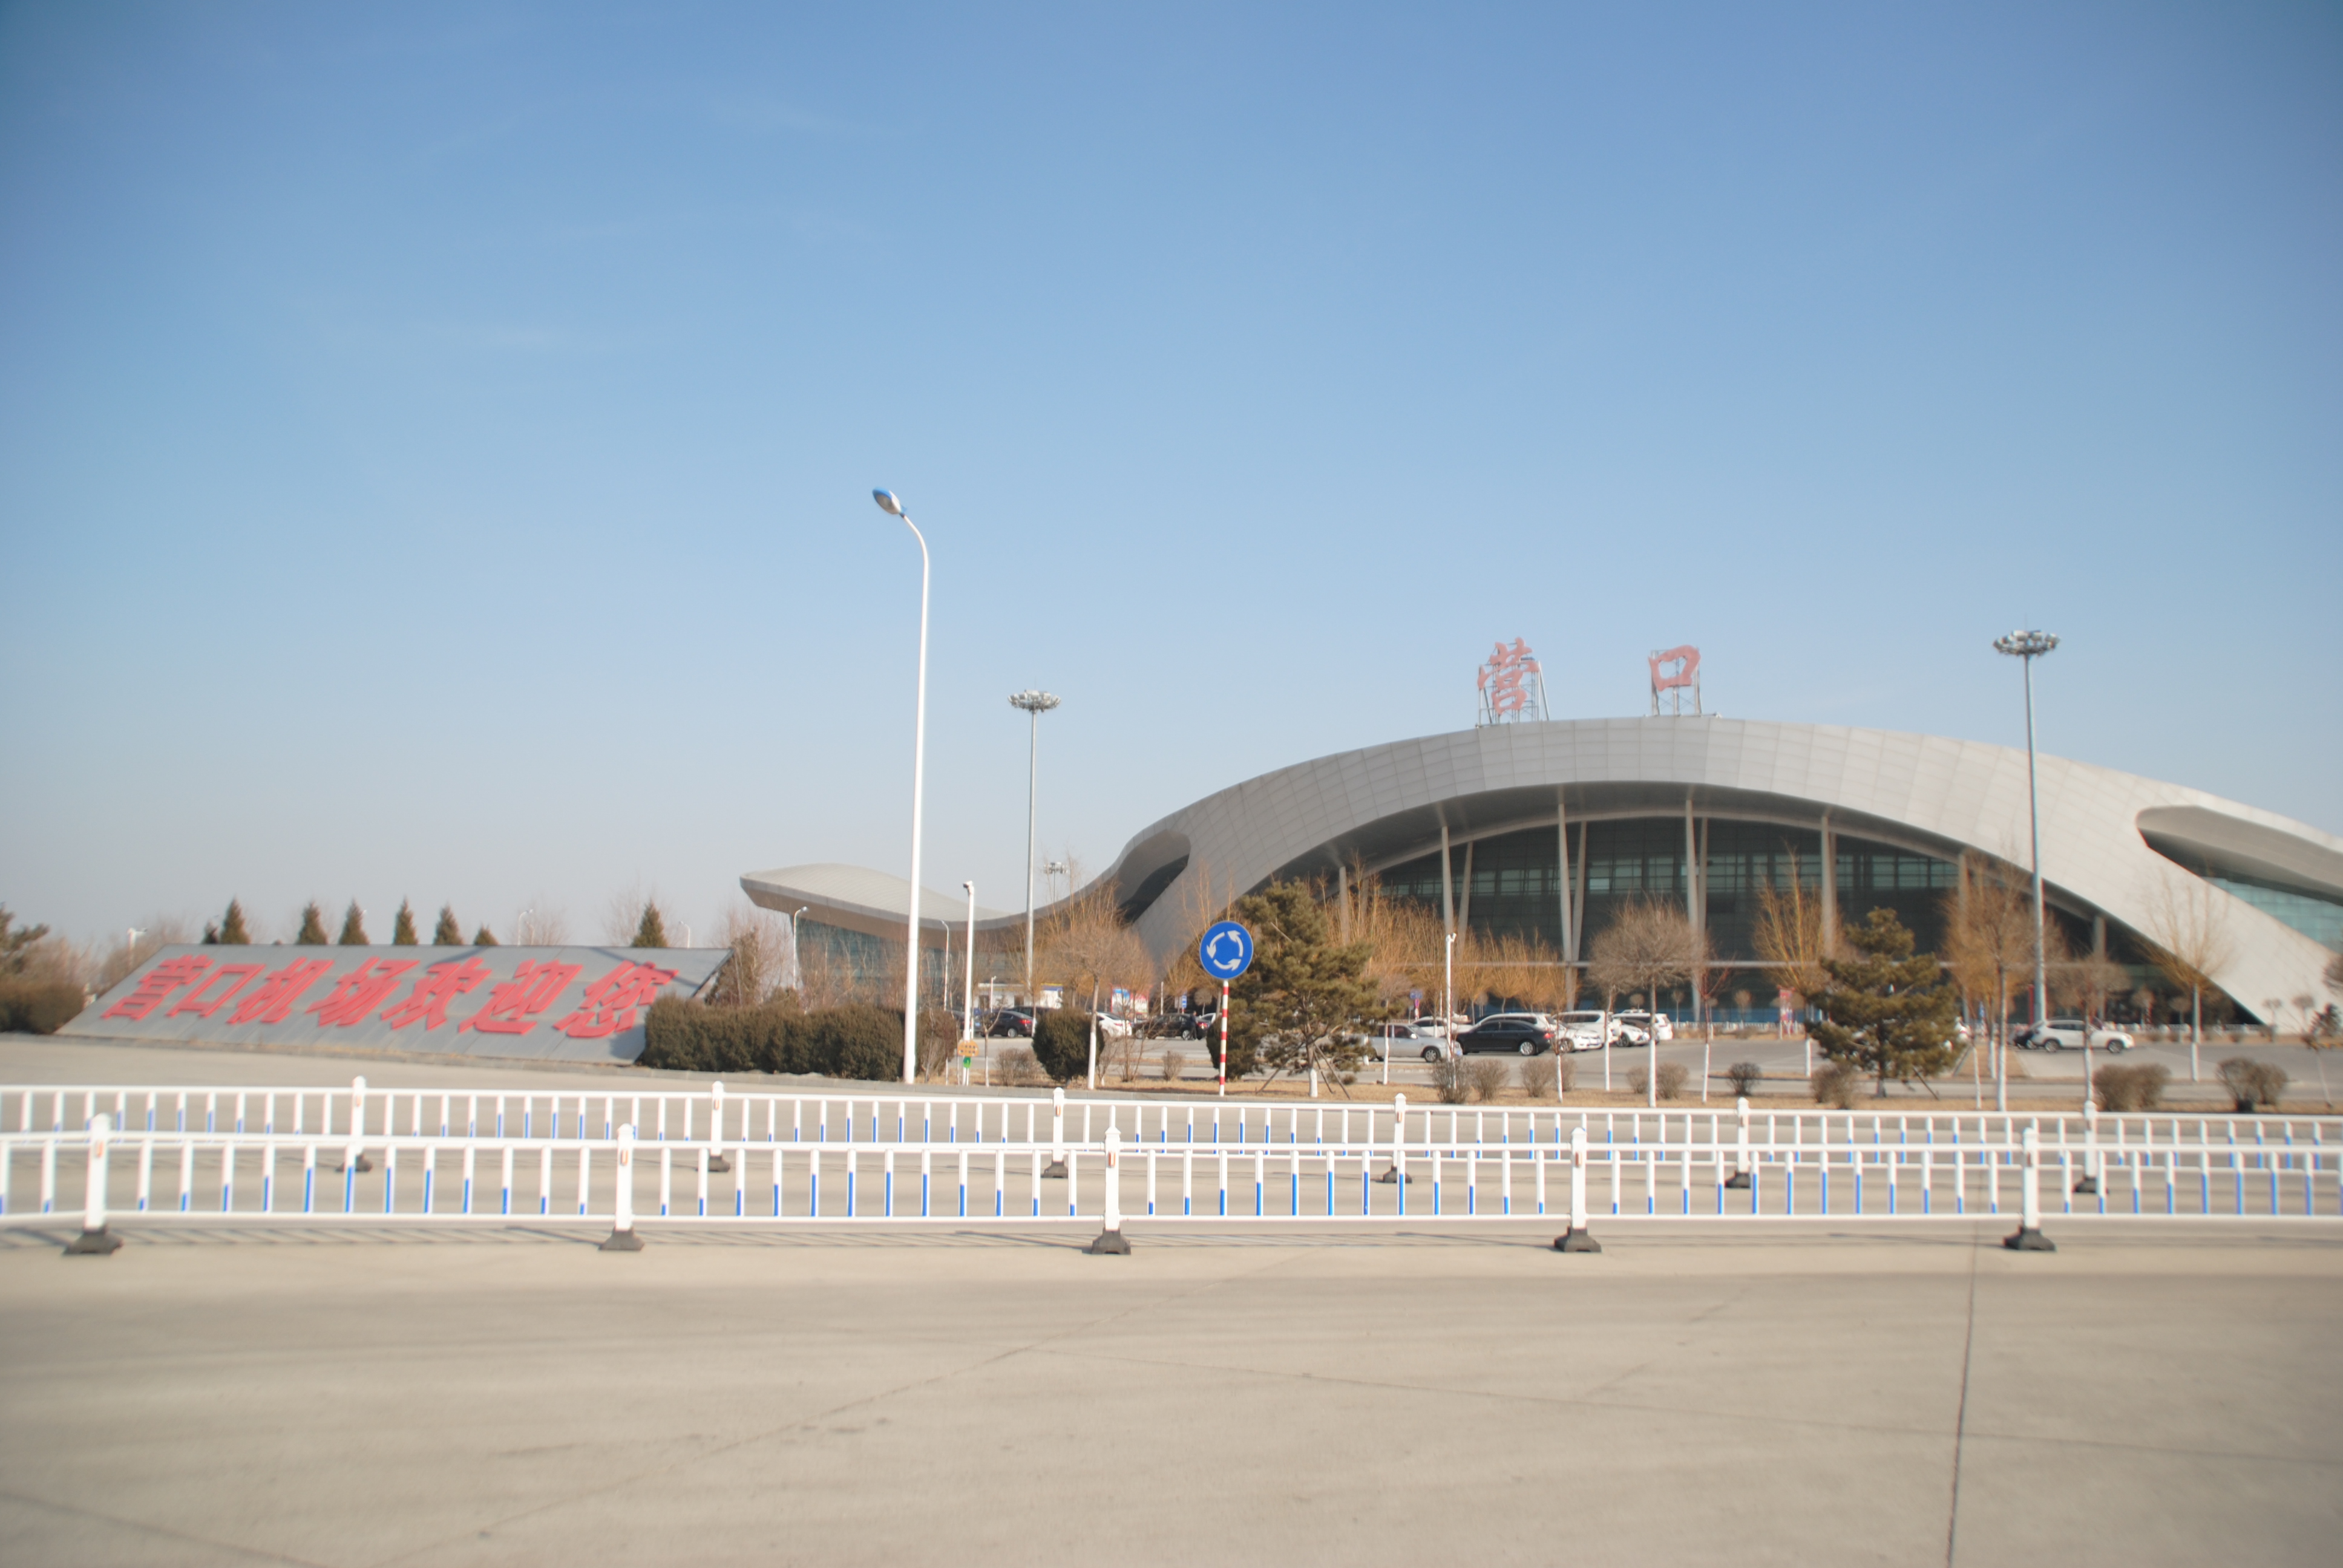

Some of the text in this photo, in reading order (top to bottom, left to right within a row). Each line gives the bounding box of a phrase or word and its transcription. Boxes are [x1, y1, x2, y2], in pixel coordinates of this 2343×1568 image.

[1477, 637, 1701, 714] 营口
[100, 955, 679, 1038] 营口机场欢迎您
